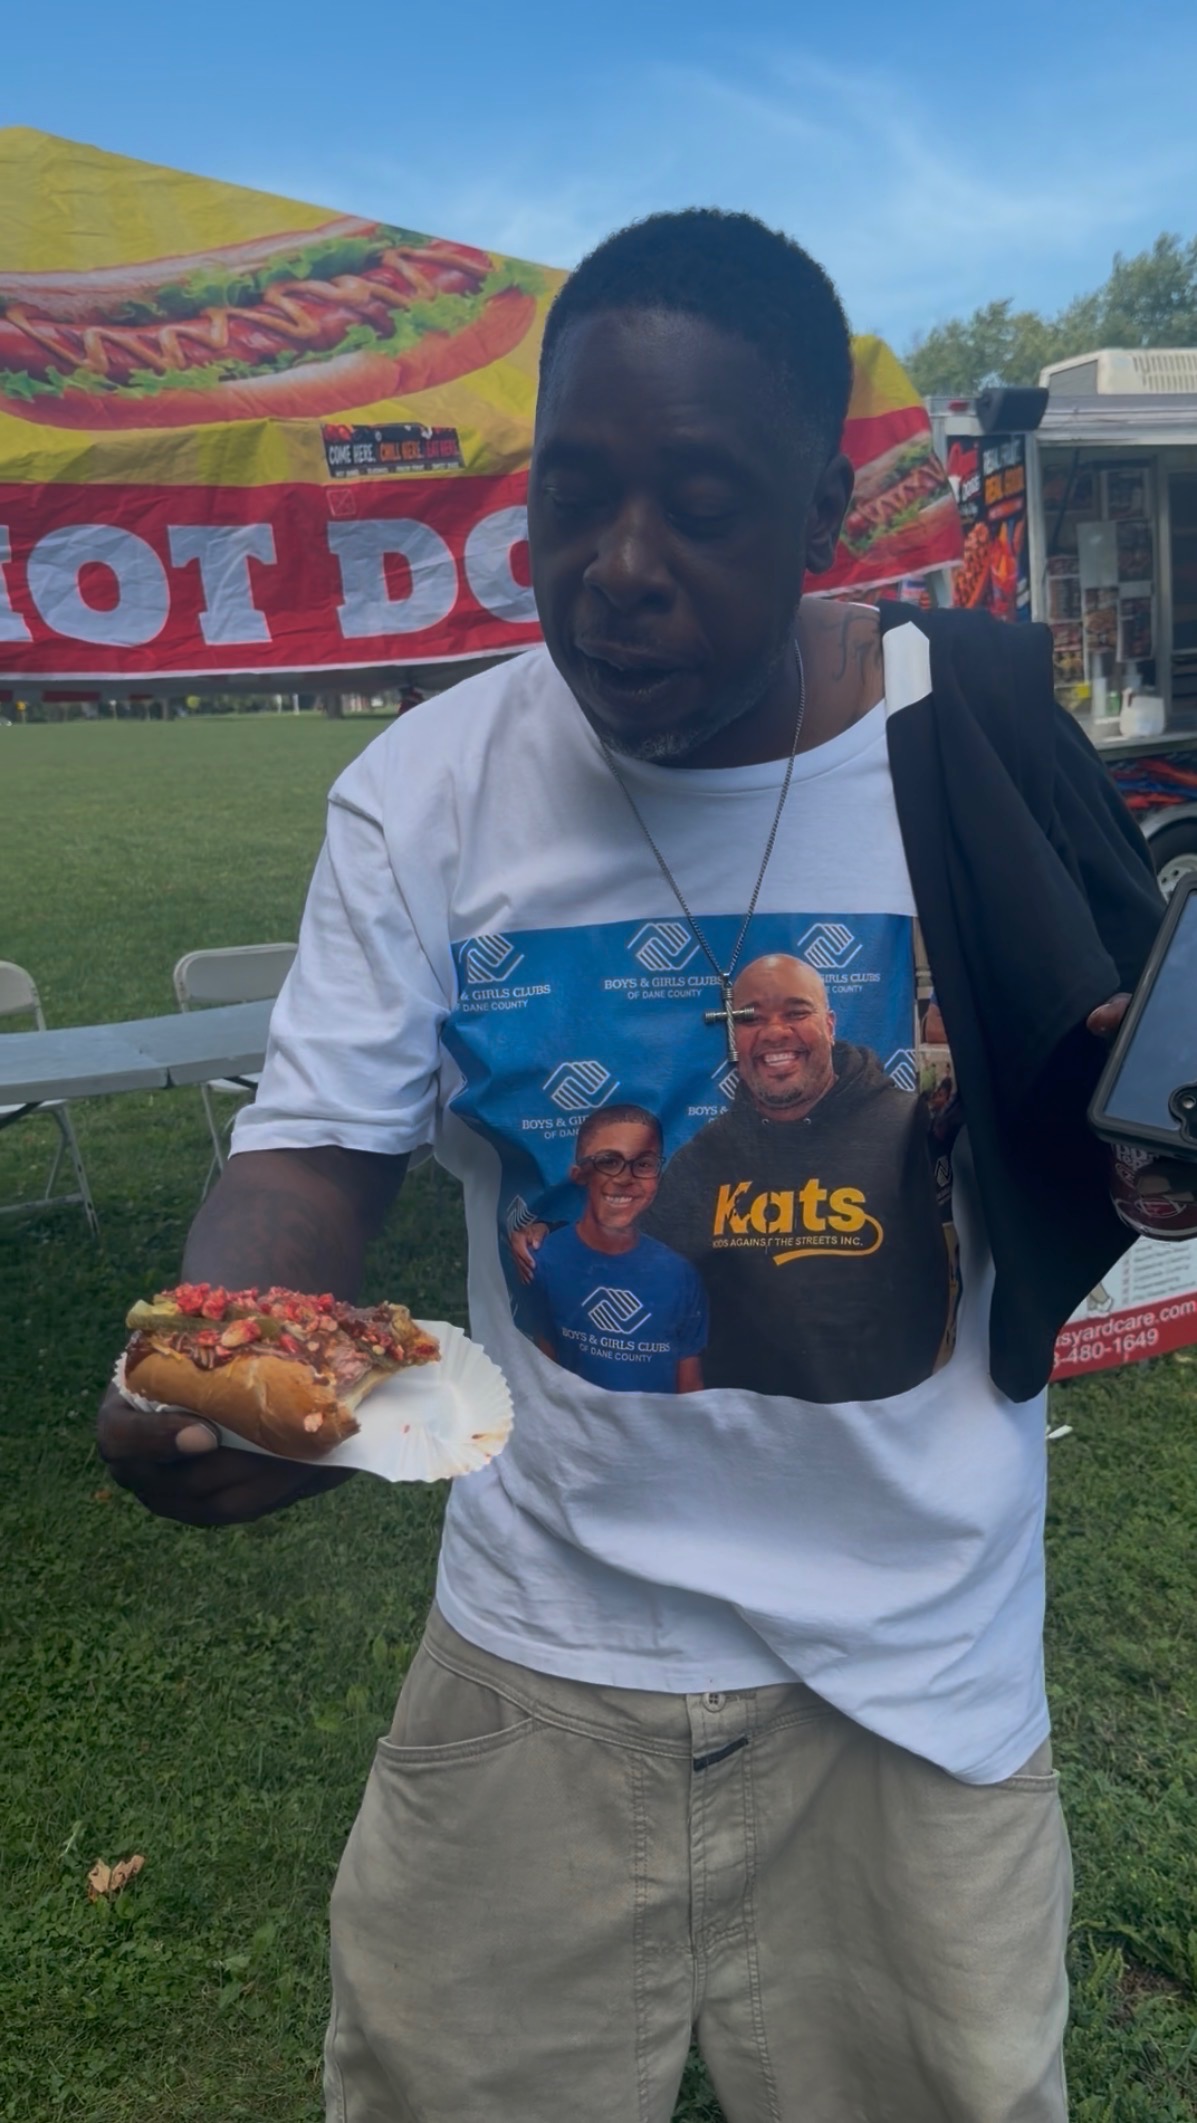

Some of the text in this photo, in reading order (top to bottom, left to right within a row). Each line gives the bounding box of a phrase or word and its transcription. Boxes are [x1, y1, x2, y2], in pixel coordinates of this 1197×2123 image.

[329, 445, 352, 465] COME
[0, 505, 541, 648] OT DO
[604, 975, 723, 990] BOYS & GIRLS CLUBS
[821, 973, 881, 983] IRLS CLUBS
[472, 987, 510, 1000] GIRLS
[512, 984, 551, 997] CLUBS
[627, 988, 702, 1000] OF DANE COUNTY
[832, 985, 863, 994] COUNTY
[463, 1002, 489, 1012] DANE
[491, 999, 529, 1011] COUNTY
[688, 1105, 718, 1116] BOYS
[522, 1118, 553, 1130] BOYS
[556, 1117, 566, 1127] &
[544, 1128, 580, 1140] OF DAN
[713, 1178, 866, 1235] Kats
[730, 1237, 773, 1247] AGAINST
[775, 1237, 794, 1246] THE
[795, 1235, 838, 1246] STREETS
[840, 1235, 863, 1246] INC.
[561, 1327, 671, 1352] BOYS & GIRLS CLUBS
[590, 1347, 613, 1359] DANE
[614, 1352, 653, 1363] COUNTY
